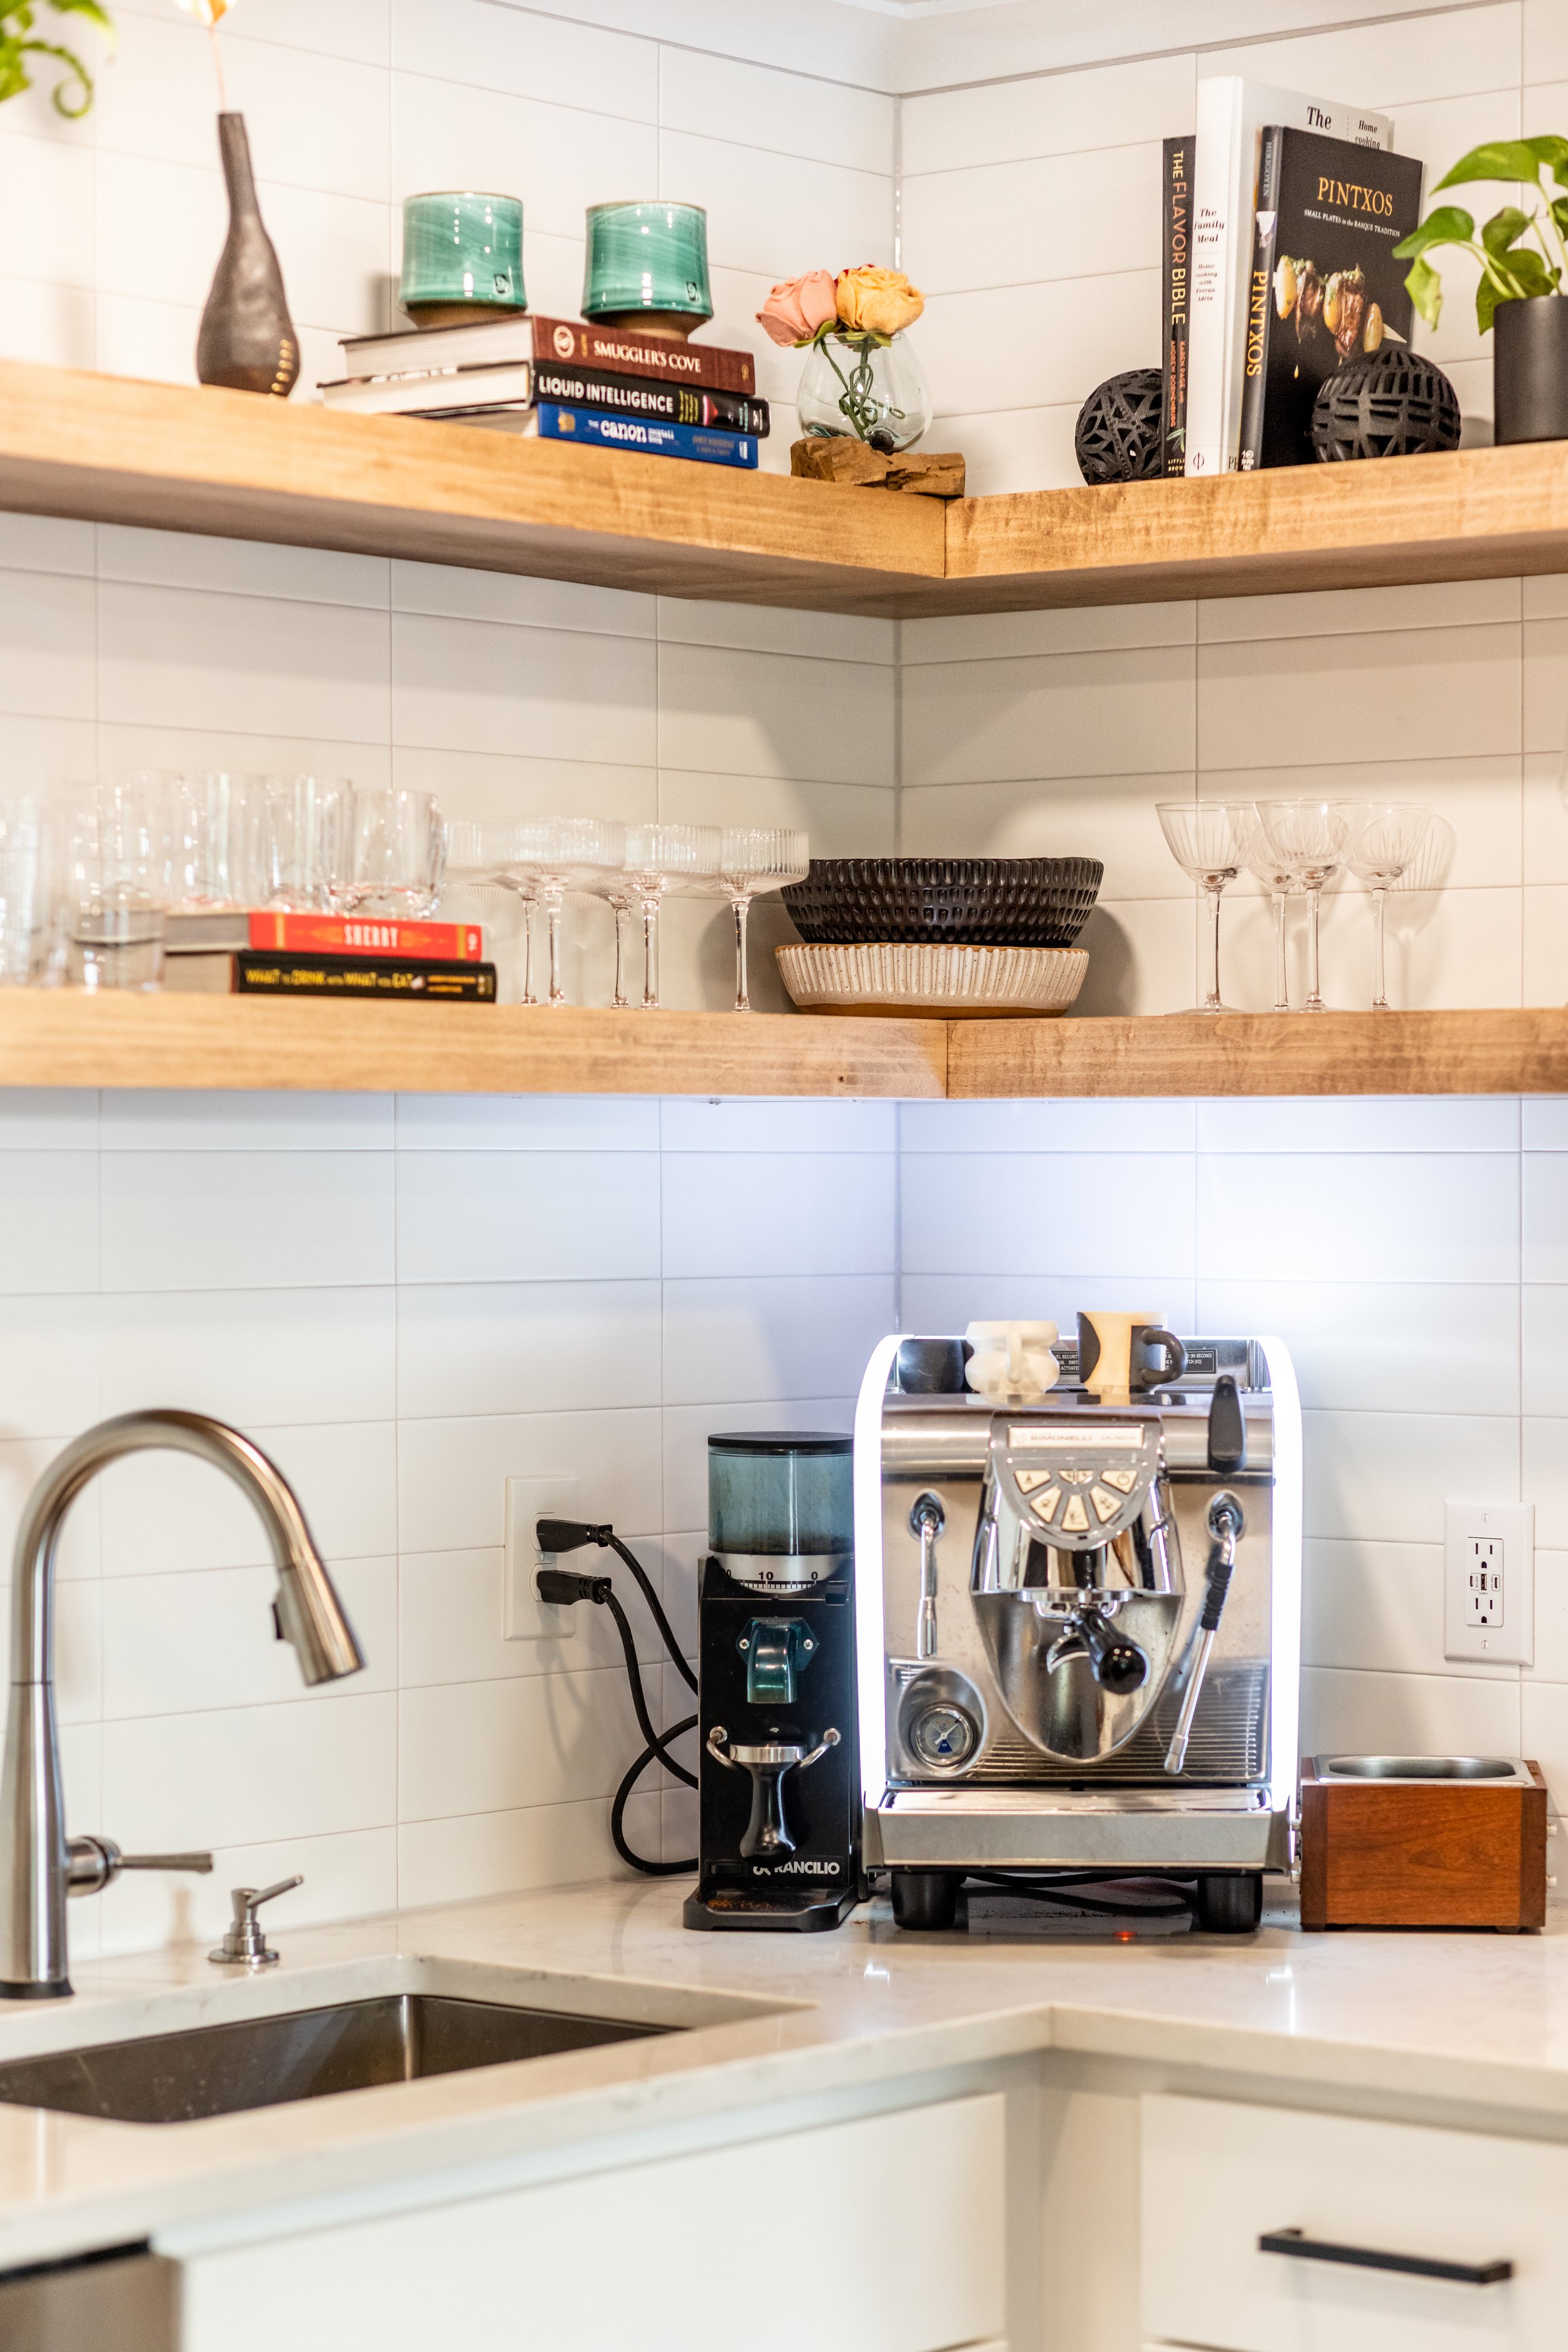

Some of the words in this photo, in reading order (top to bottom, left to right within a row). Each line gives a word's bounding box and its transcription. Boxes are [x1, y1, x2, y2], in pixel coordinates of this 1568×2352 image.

[1306, 105, 1332, 130] The
[1358, 120, 1378, 134] Home
[1355, 136, 1380, 150] cooking
[1172, 150, 1184, 179] THE
[1317, 176, 1392, 216] PINTXOS
[1172, 181, 1187, 263] FLAVOR
[1194, 220, 1224, 230] Family
[1199, 208, 1217, 217] The
[1304, 208, 1322, 220] SMALL
[1322, 213, 1342, 224] PLATES
[1353, 220, 1374, 231] BASQUE
[1374, 225, 1401, 237] TRADITION
[1197, 234, 1219, 243] Meal
[1172, 268, 1186, 326] BIBLE
[1246, 270, 1269, 376] PINTXOS
[593, 340, 667, 367] SMUGGLER'S
[669, 354, 701, 373] COVE
[539, 376, 585, 399] LIQUID
[586, 383, 674, 413] INTELLIGENCE
[600, 420, 647, 443] canon
[758, 1572, 774, 1580] 10
[810, 1571, 818, 1580] 0
